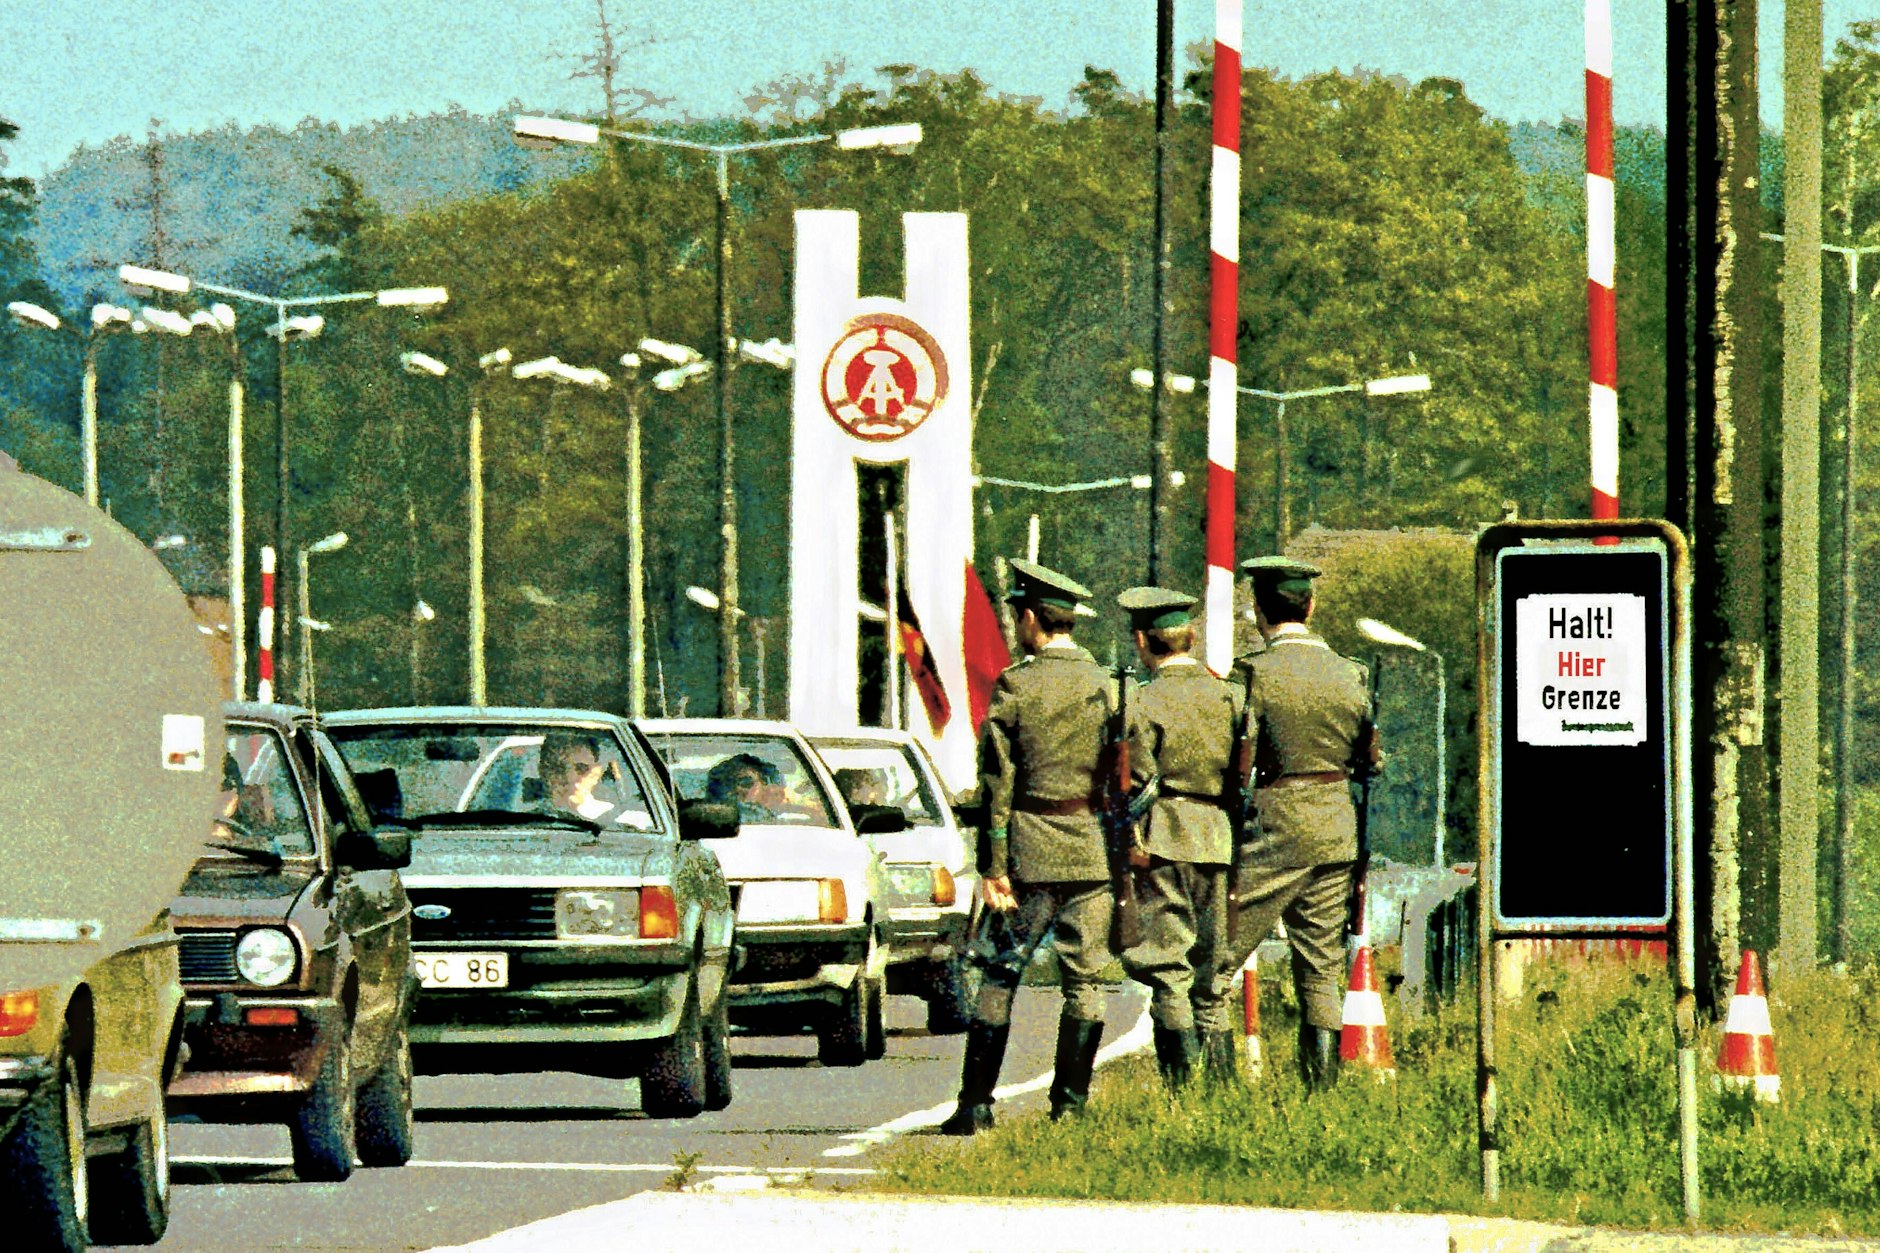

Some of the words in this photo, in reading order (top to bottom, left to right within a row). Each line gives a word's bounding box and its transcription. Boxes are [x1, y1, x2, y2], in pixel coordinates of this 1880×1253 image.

[1549, 606, 1613, 639] Halt!
[1558, 651, 1606, 677] Hier
[1542, 684, 1621, 710] Grenze
[467, 959, 500, 983] 86
